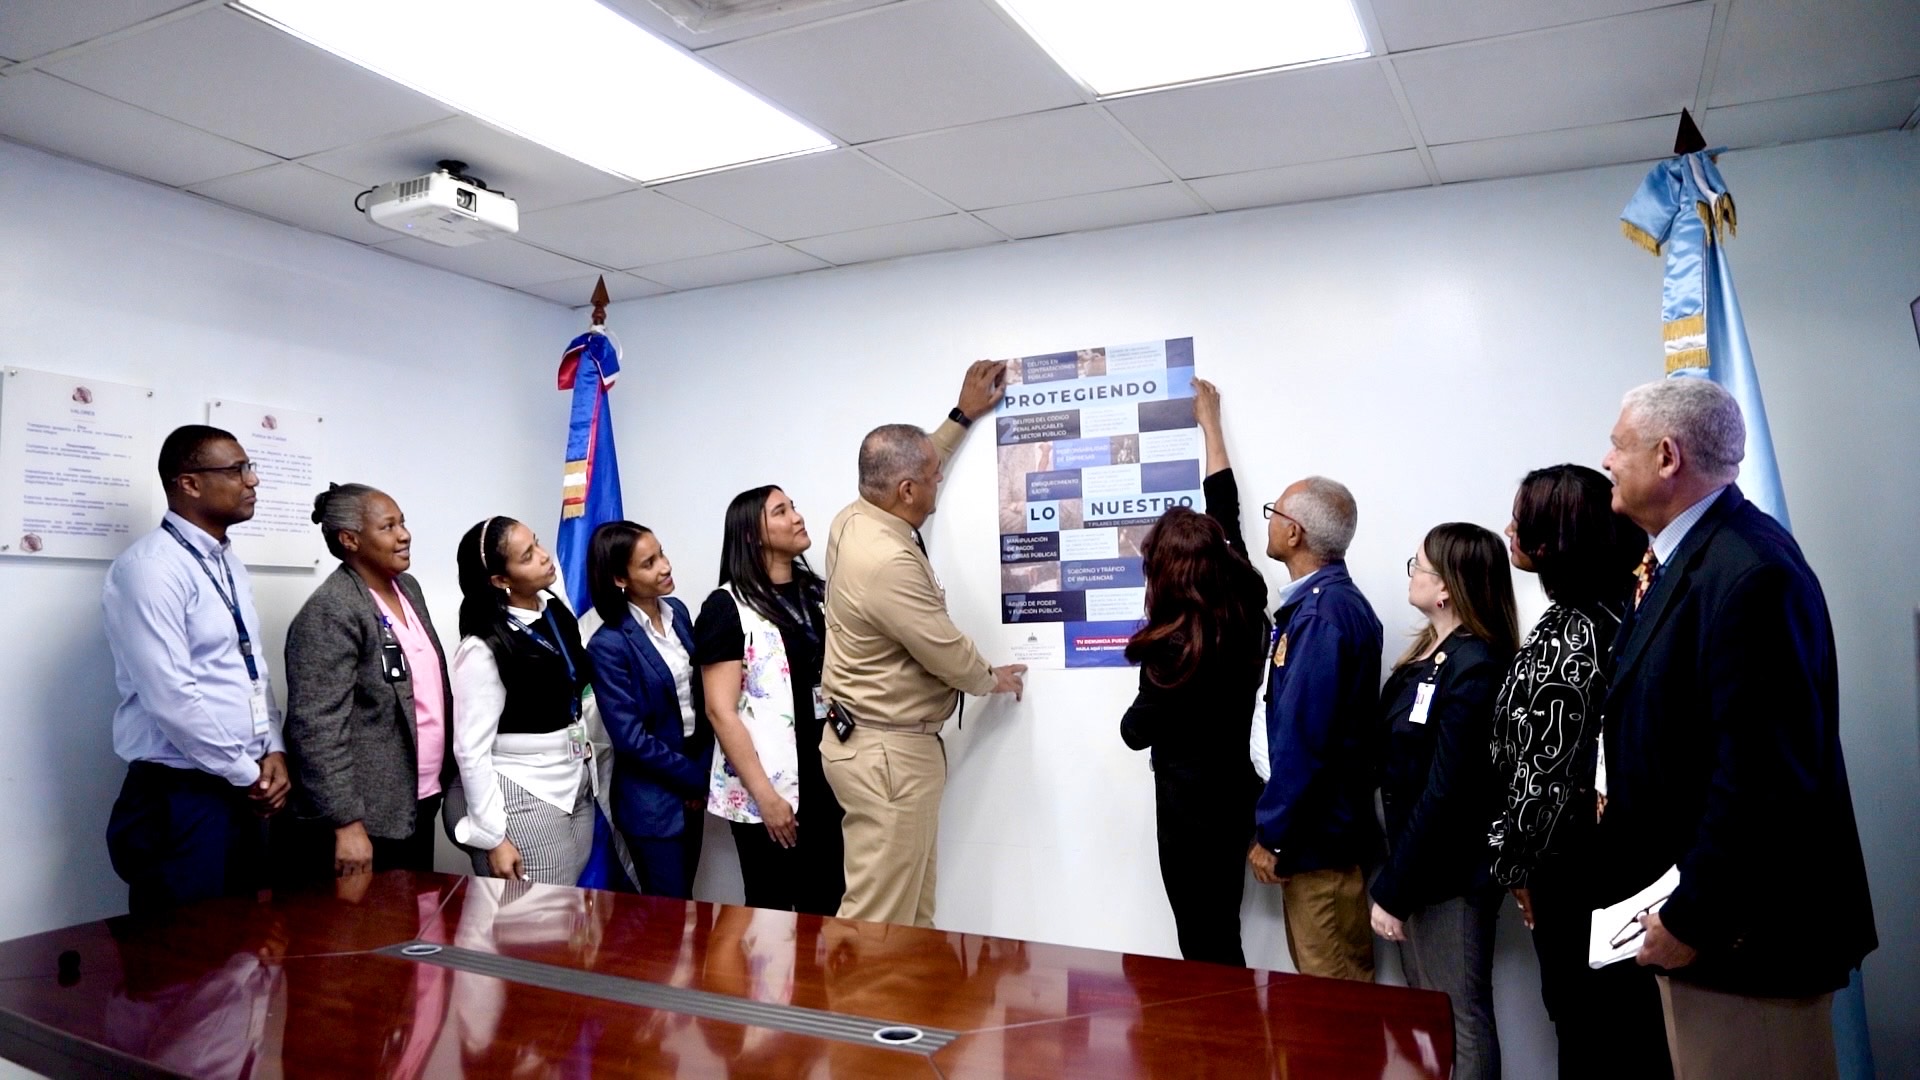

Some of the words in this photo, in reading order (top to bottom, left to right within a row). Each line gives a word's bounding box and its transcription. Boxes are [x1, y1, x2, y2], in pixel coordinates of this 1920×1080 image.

[1005, 381, 1157, 409] PROTEGIENDO
[1047, 414, 1070, 422] CÓDIGO
[1031, 423, 1064, 431] APLICABLES
[1031, 507, 1055, 520] LO
[1091, 496, 1193, 516] NUESTRO
[1076, 574, 1114, 582] INFLUENCIAS
